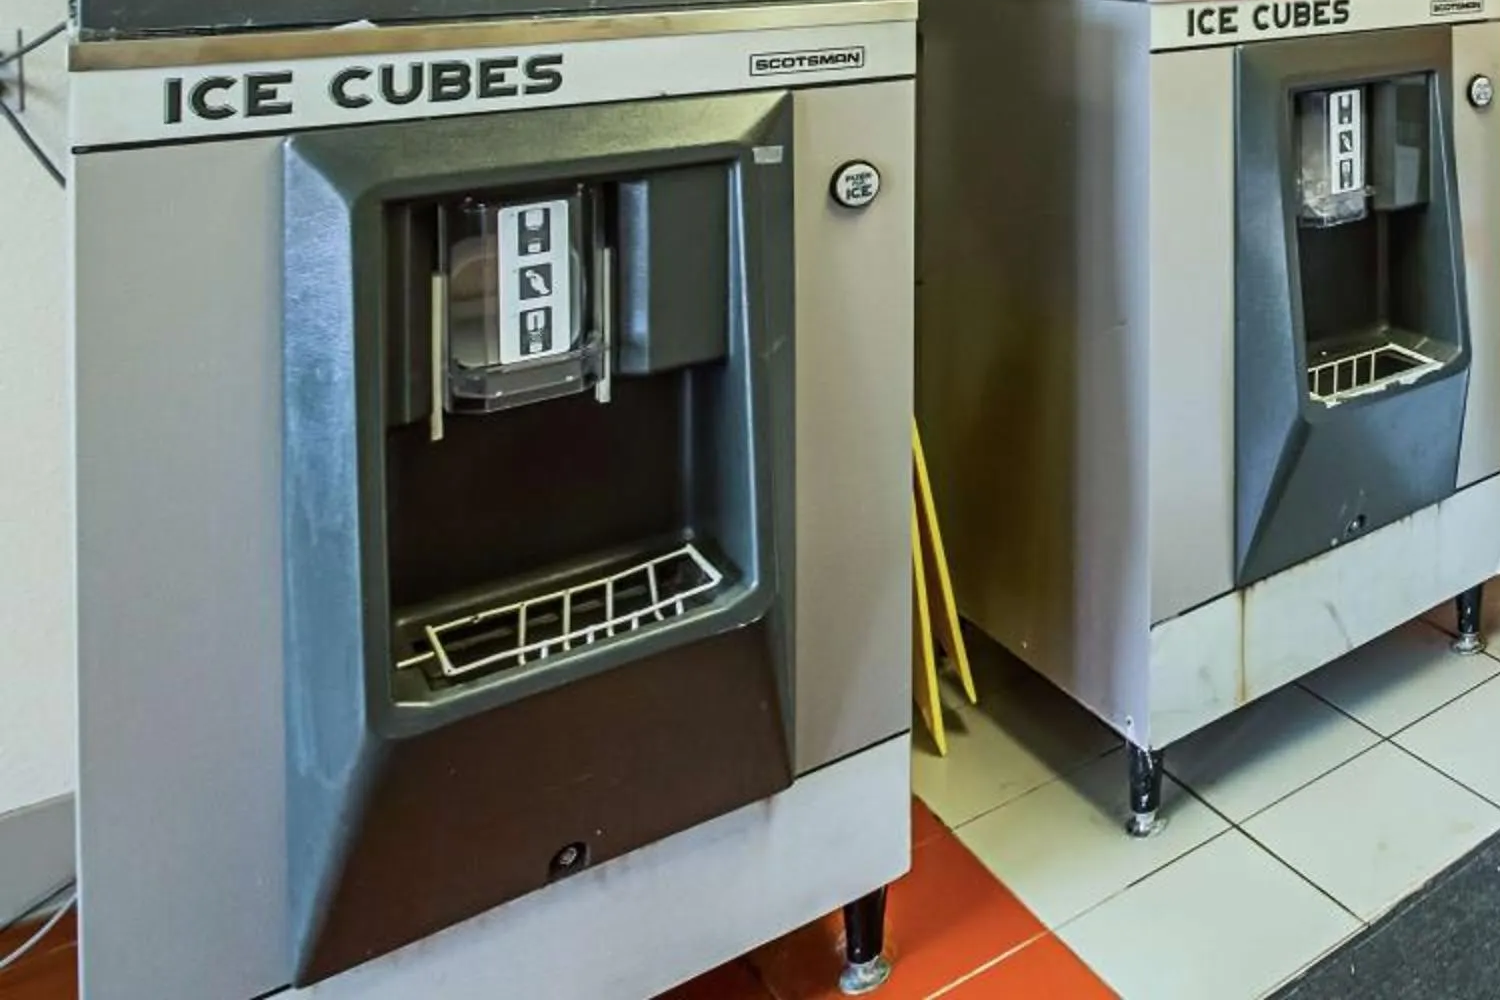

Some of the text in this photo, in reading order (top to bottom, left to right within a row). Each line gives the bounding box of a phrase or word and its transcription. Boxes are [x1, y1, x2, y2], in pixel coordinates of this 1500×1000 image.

[1187, 0, 1350, 37] ICE CUBES
[755, 53, 860, 71] SCOTSMAN
[163, 54, 563, 125] ICE CUBES
[846, 184, 873, 200] ICE
